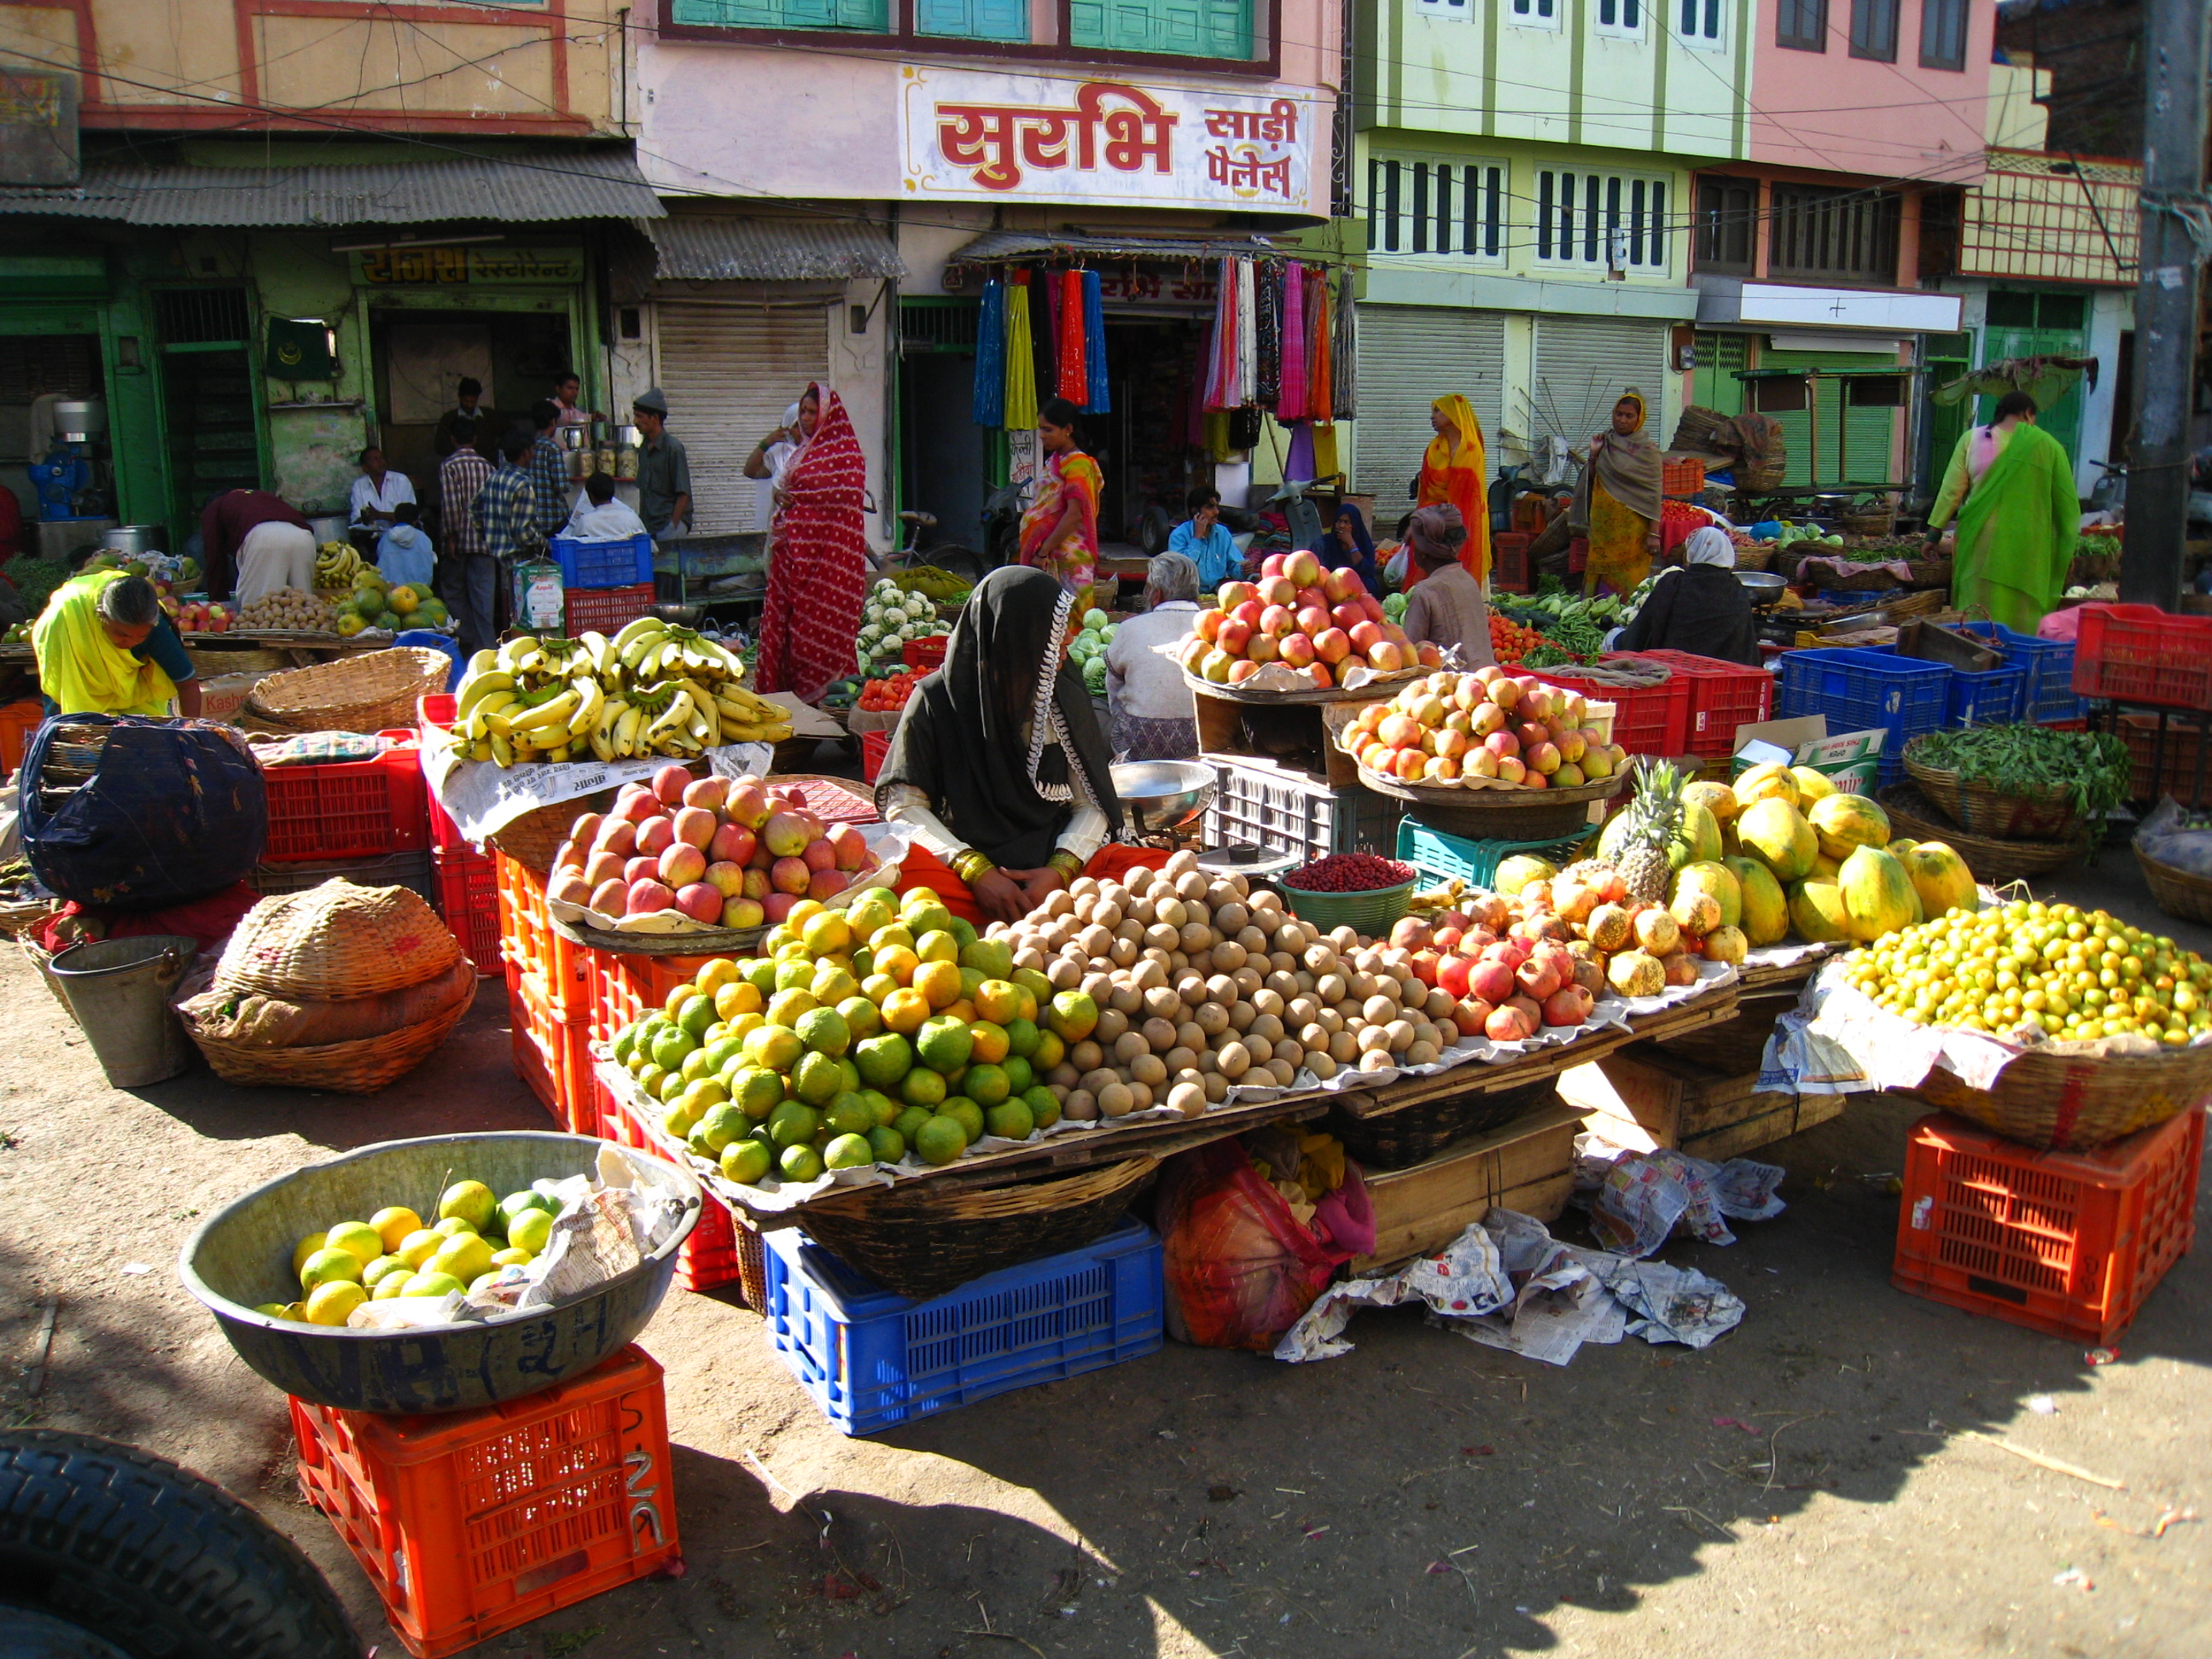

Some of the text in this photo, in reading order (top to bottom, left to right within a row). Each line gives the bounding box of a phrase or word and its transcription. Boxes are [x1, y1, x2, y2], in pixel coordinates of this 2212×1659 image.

[937, 84, 1298, 191] सुरभि साड़ी
[1204, 146, 1291, 199] पेलेस
